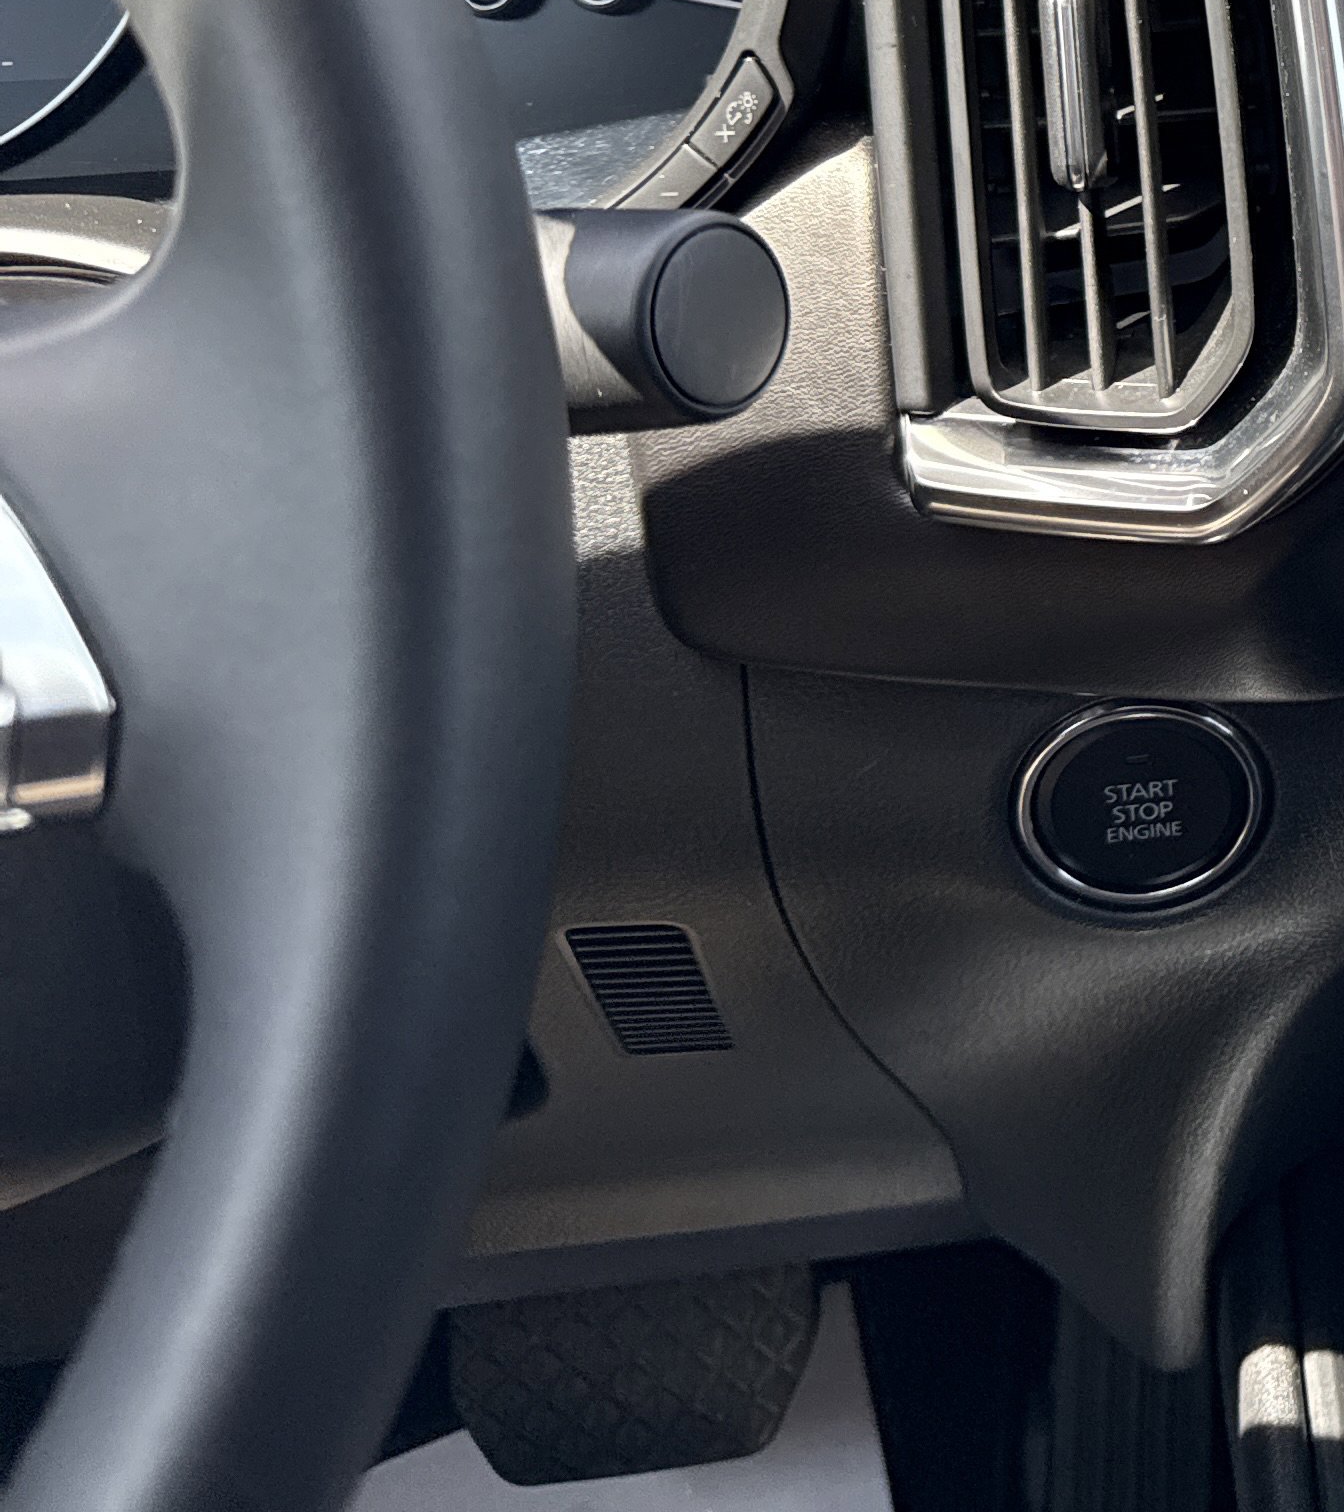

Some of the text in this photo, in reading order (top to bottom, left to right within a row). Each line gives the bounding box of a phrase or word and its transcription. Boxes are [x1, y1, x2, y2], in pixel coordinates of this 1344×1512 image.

[1103, 778, 1179, 804] START
[1112, 800, 1174, 824] STOP
[1106, 820, 1183, 844] ENGINE
